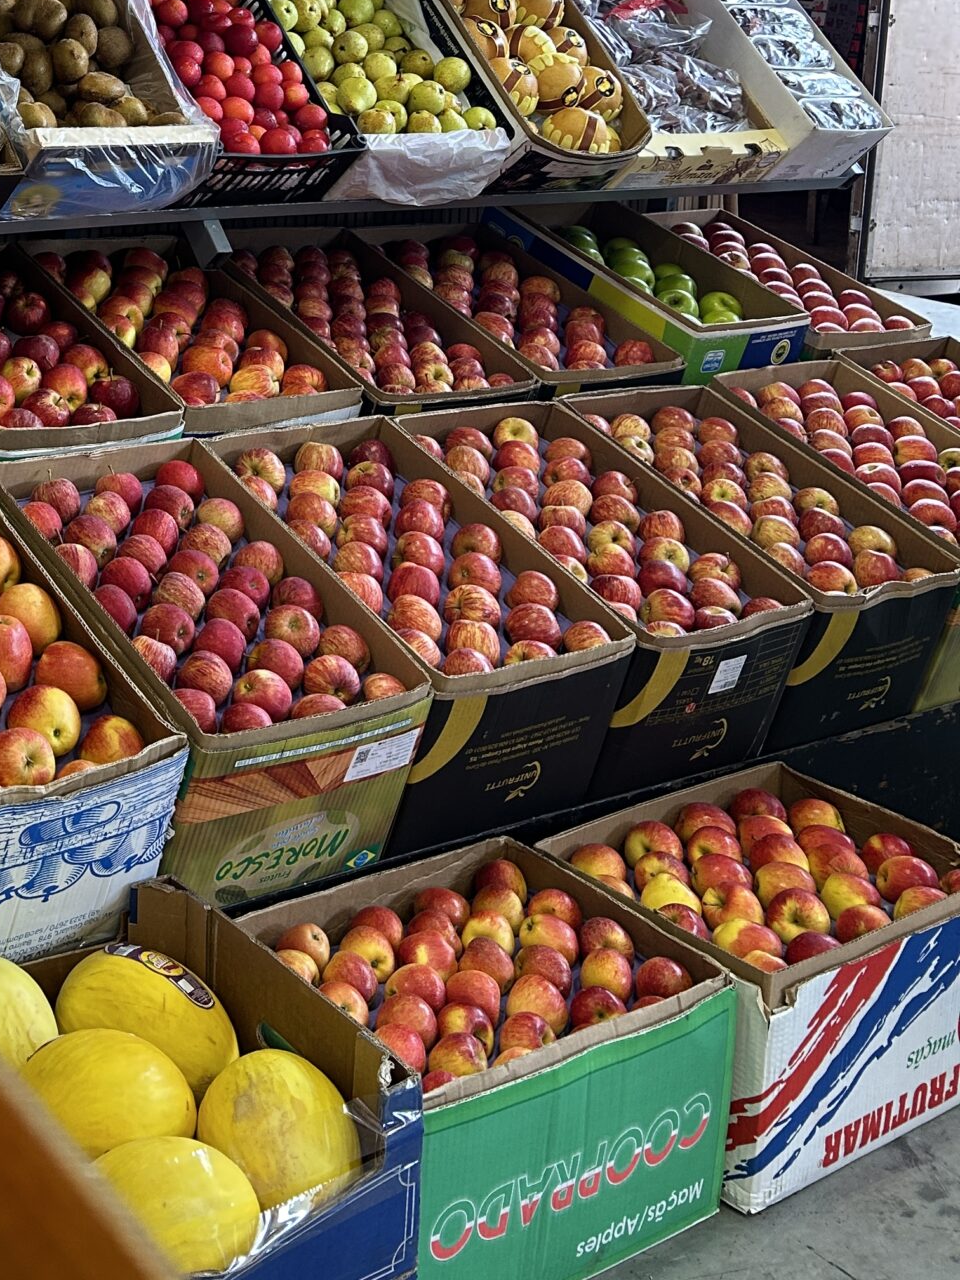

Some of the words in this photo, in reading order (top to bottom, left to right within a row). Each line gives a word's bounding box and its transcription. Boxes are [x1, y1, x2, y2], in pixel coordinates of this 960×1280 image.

[701, 654, 716, 666] 18
[671, 727, 725, 748] UNIFRUTTI
[484, 770, 538, 792] UNIFRUTTI
[258, 869, 291, 884] Frutas
[906, 1029, 957, 1070] maçãs
[823, 1063, 960, 1168] FRUTIMAR
[429, 1091, 712, 1261] COOPRADO
[575, 1178, 705, 1258] Maçãs/Apples
